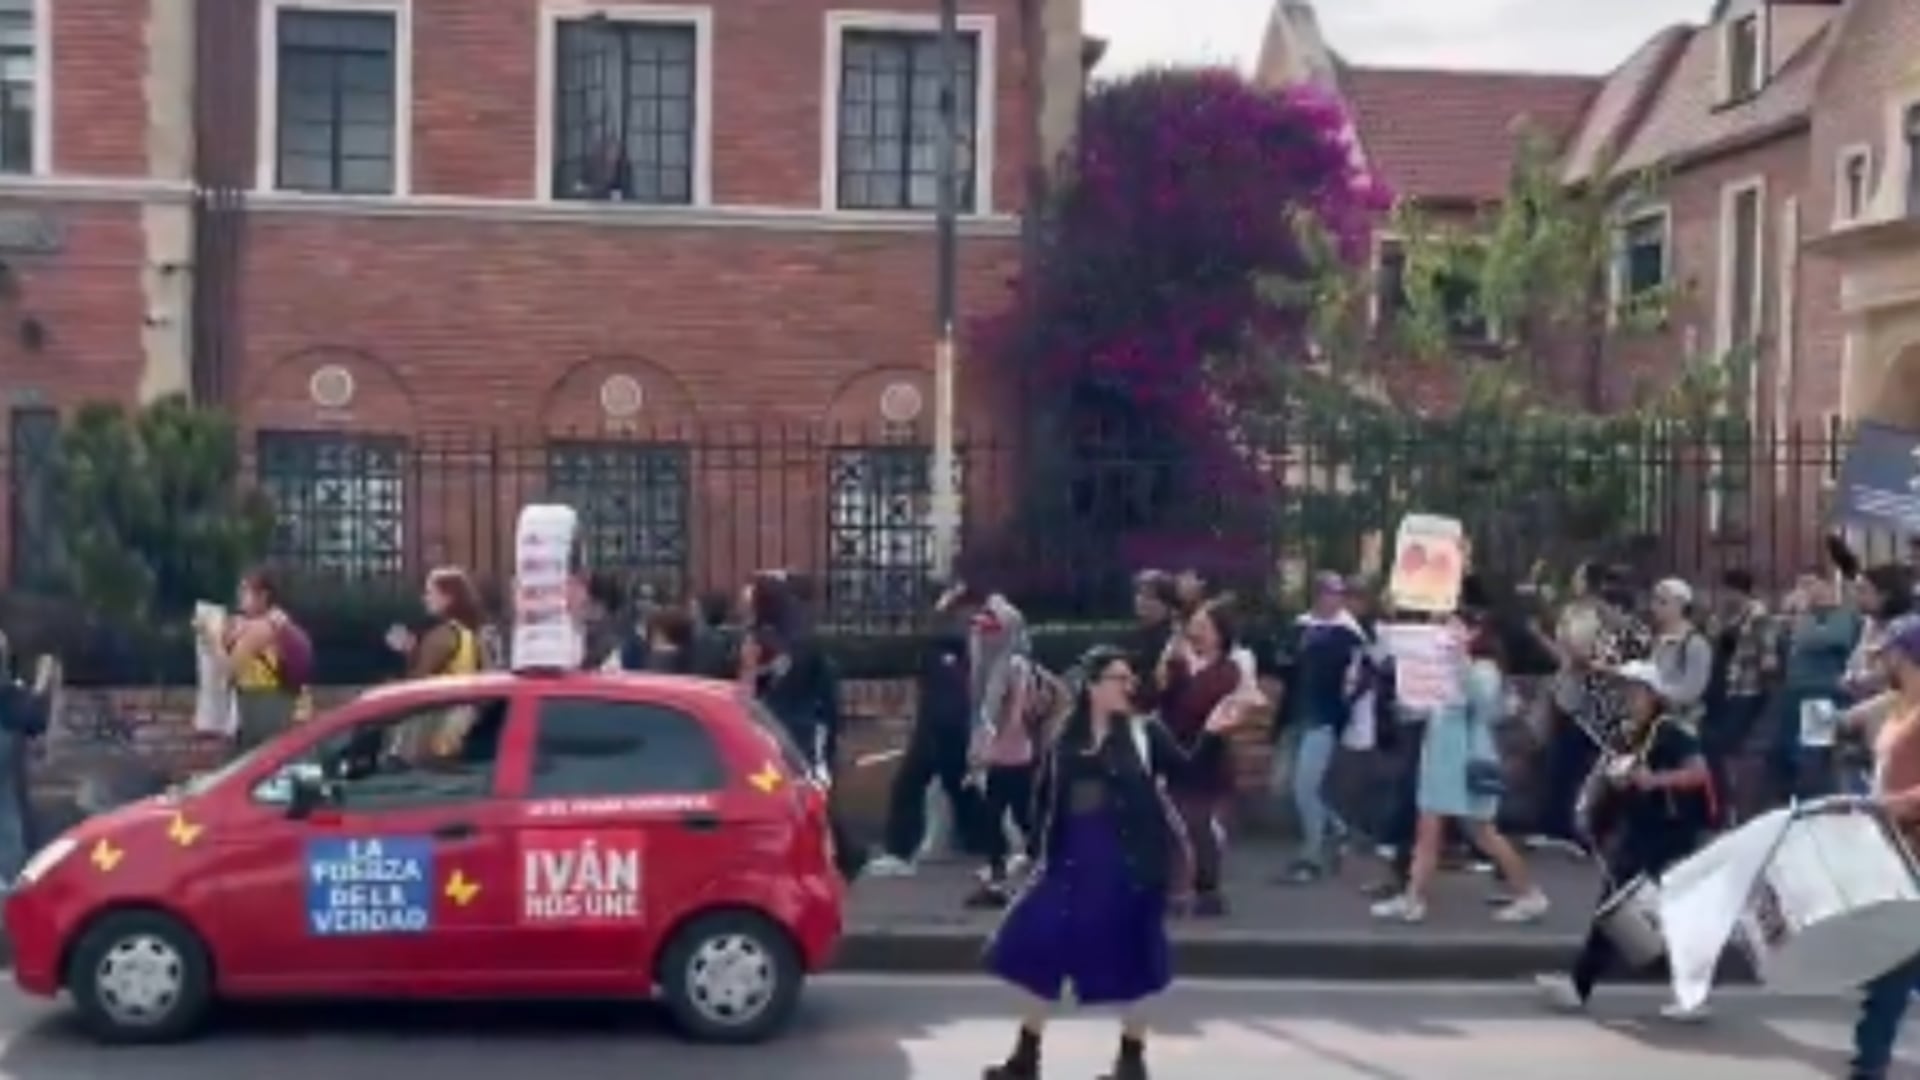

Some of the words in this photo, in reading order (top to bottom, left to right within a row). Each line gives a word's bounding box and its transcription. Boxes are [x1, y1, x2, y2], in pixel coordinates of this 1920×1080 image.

[347, 838, 382, 859] LA
[311, 858, 423, 884] FUERZA
[524, 838, 638, 893] IVÁN
[524, 894, 581, 918] NOS
[586, 893, 641, 917] UNE
[311, 907, 428, 932] VERDAD
